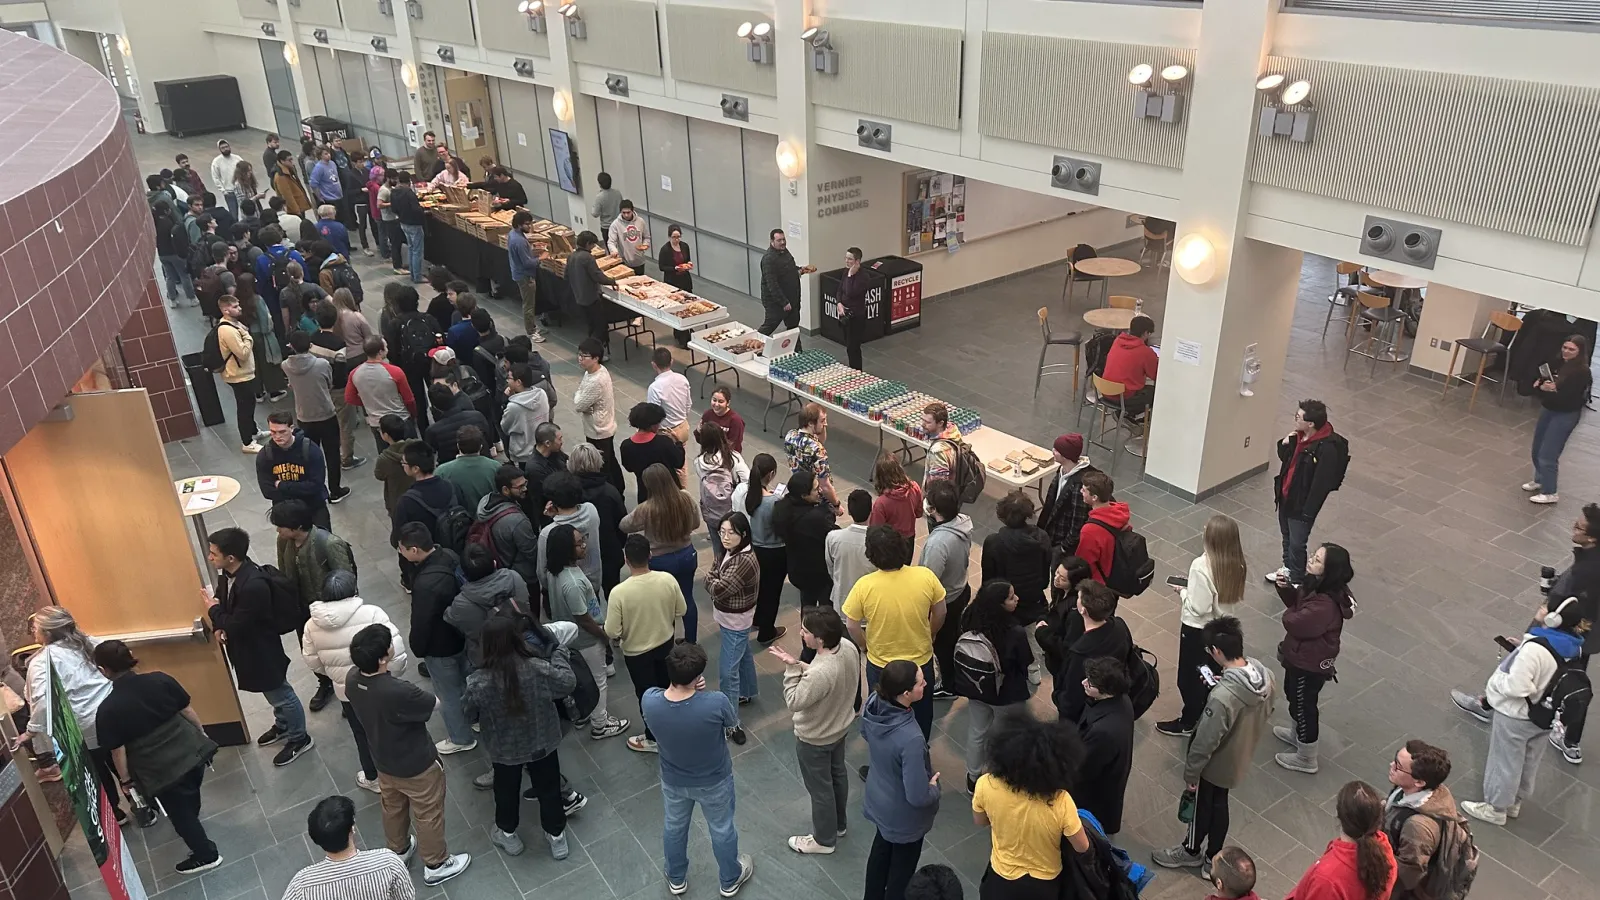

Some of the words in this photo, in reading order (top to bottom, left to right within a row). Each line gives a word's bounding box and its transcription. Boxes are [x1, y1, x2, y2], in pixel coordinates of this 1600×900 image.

[419, 65, 433, 128] ADMINIST
[817, 176, 862, 192] VERNIER
[817, 188, 861, 206] PHYSICS
[817, 199, 869, 218] COMMONS
[893, 275, 920, 287] RECYCLE
[865, 287, 881, 304] ASH
